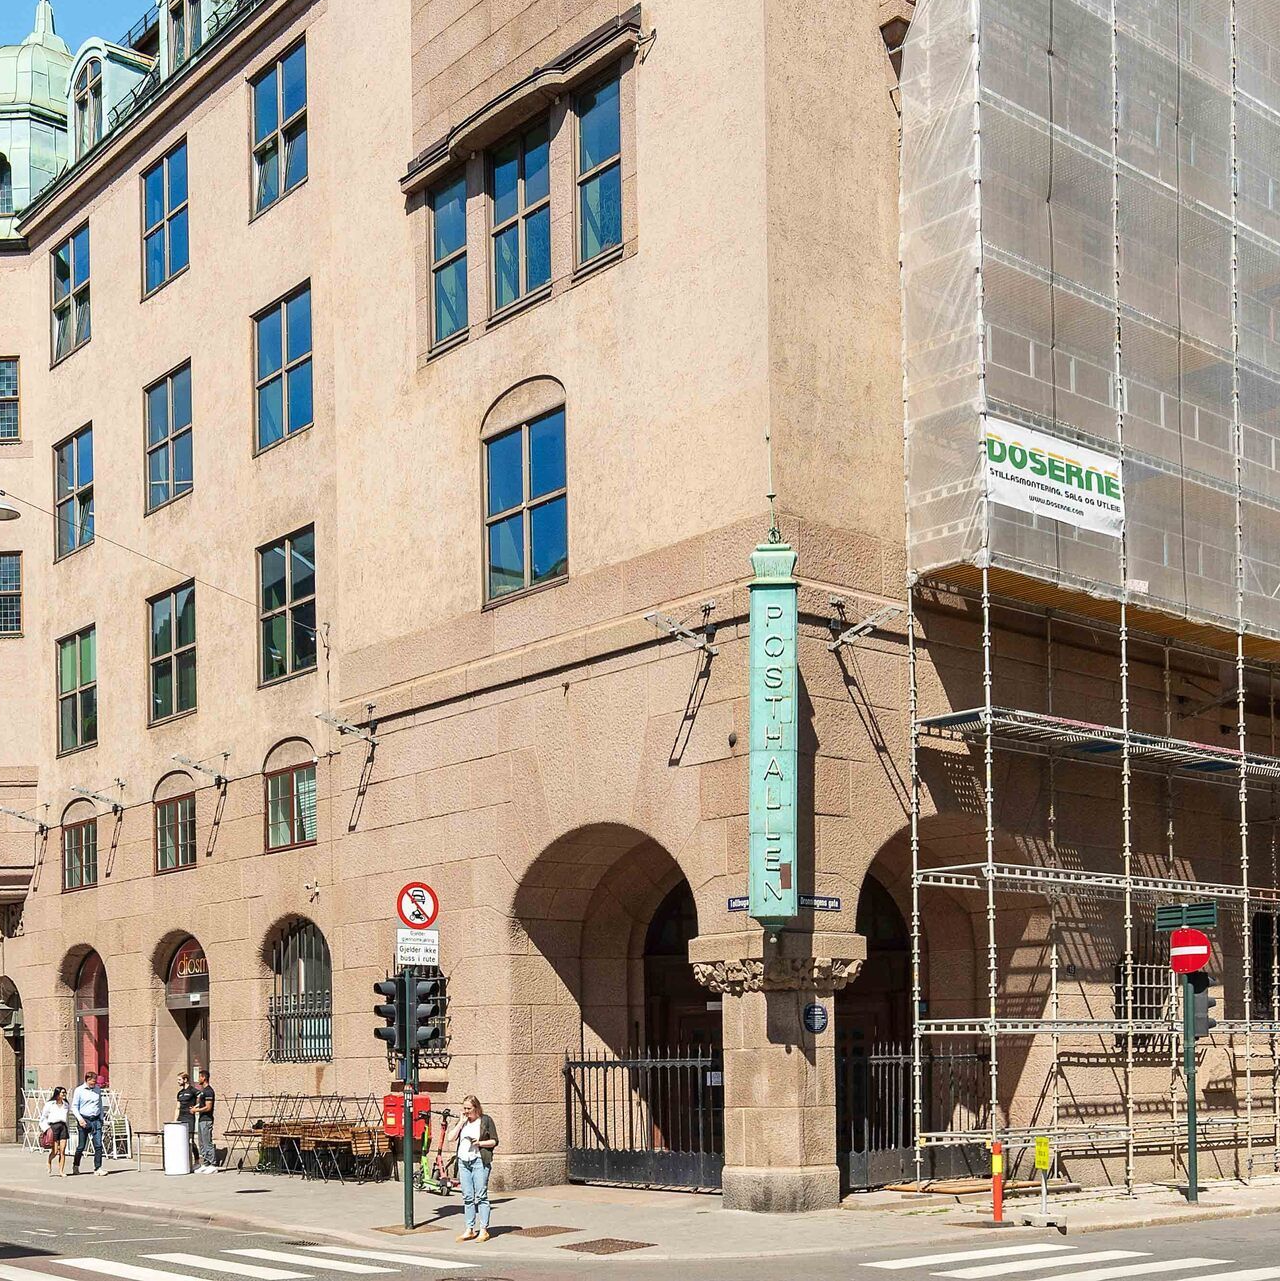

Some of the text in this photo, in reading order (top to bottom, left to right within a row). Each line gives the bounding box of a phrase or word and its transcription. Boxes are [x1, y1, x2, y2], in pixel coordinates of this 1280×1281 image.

[985, 433, 1121, 500] DOSERNE
[763, 605, 785, 902] POSTHALLEN
[400, 946, 421, 954] Gjelder
